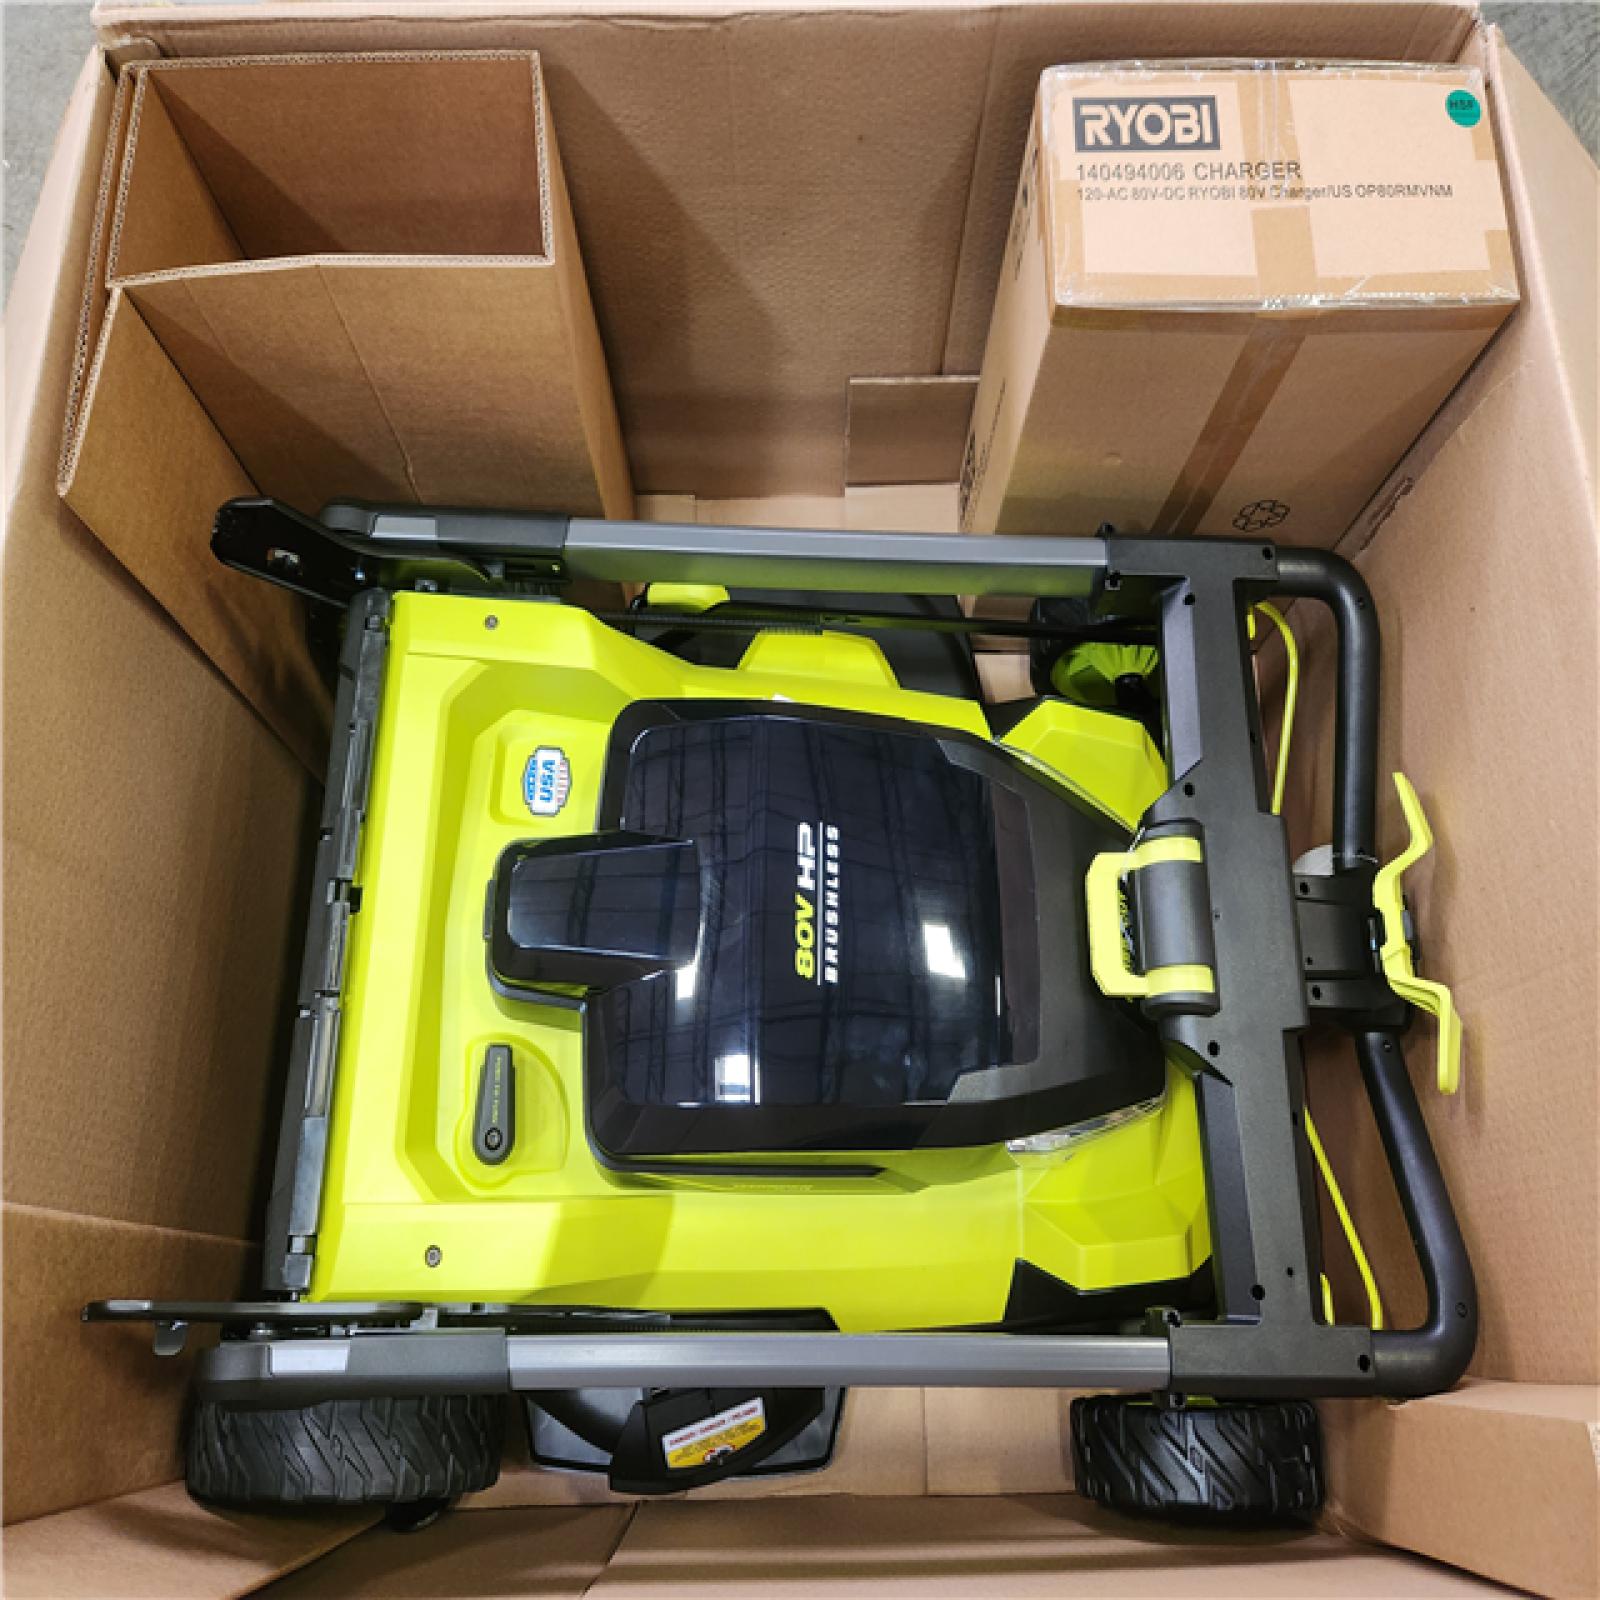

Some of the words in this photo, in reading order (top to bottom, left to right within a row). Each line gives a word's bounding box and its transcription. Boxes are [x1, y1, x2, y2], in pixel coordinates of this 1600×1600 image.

[1080, 104, 1213, 146] RYOBI
[1077, 162, 1185, 181] 140494006
[1194, 162, 1302, 181] CHARGER
[1189, 186, 1236, 200] RYOBI
[1239, 185, 1266, 200] 80V
[539, 759, 556, 802] USA
[797, 822, 816, 890] HP
[824, 824, 840, 984] BRUSHLESS
[795, 891, 815, 979] 80V
